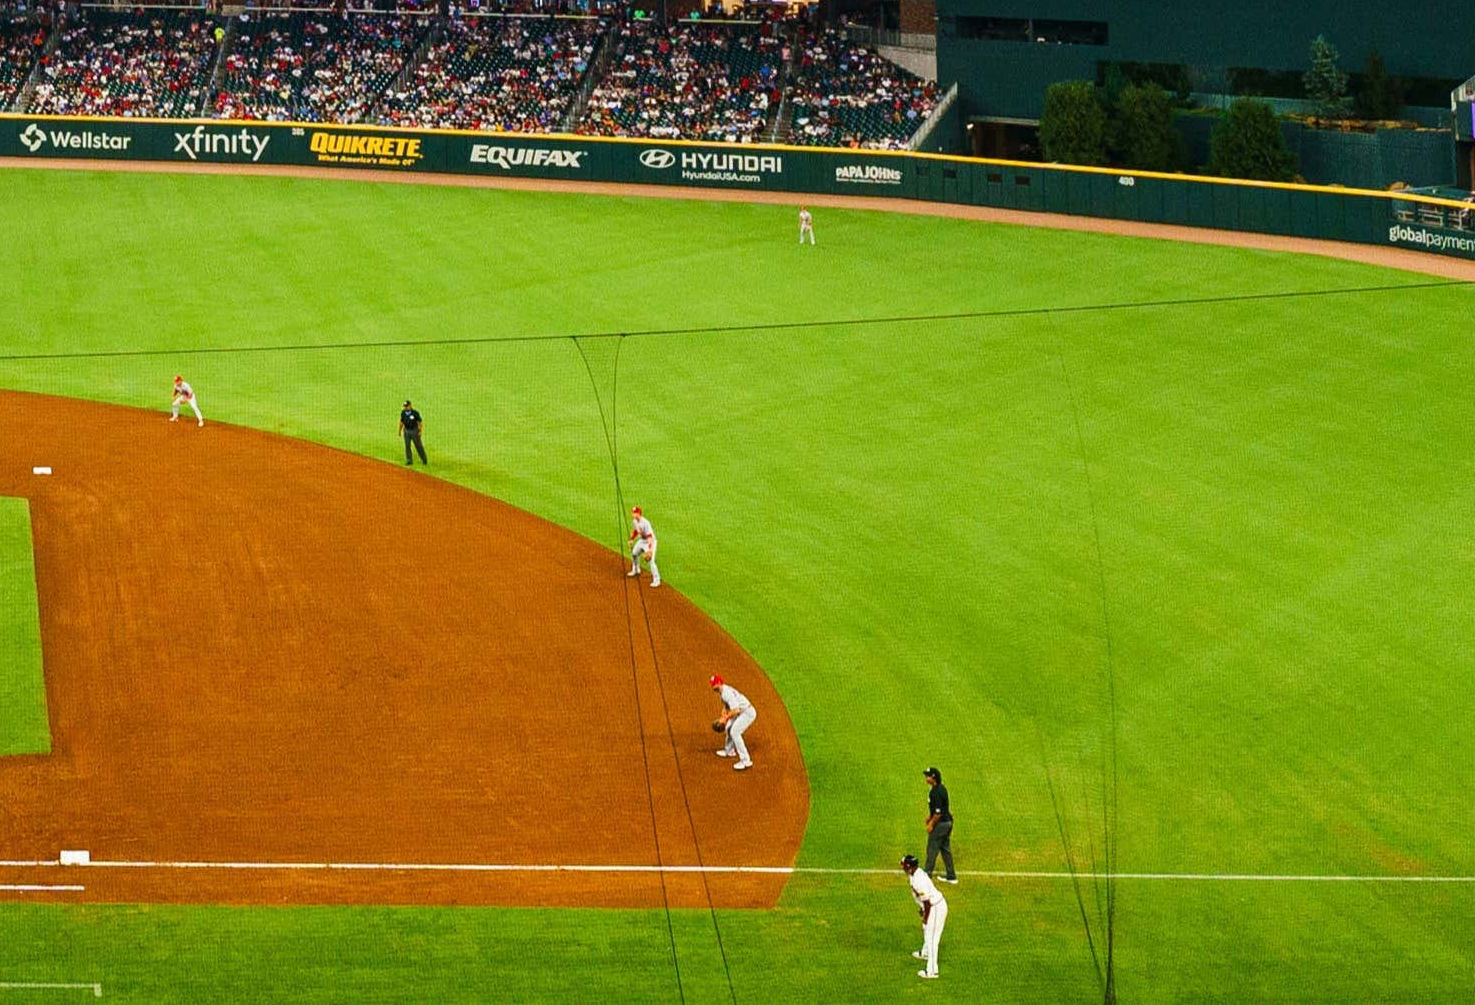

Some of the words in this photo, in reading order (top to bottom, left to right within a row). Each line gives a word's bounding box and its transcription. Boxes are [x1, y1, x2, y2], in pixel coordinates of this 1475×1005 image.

[50, 130, 131, 151] Wellstar
[174, 126, 270, 161] xfinity
[309, 132, 421, 157] QUIKRETE
[470, 144, 582, 169] EQUIFAX
[682, 152, 782, 173] HYUNDAI
[682, 169, 760, 183] HyundaiUSA.com
[836, 166, 864, 179] PAPA
[864, 166, 901, 180] JOHNS
